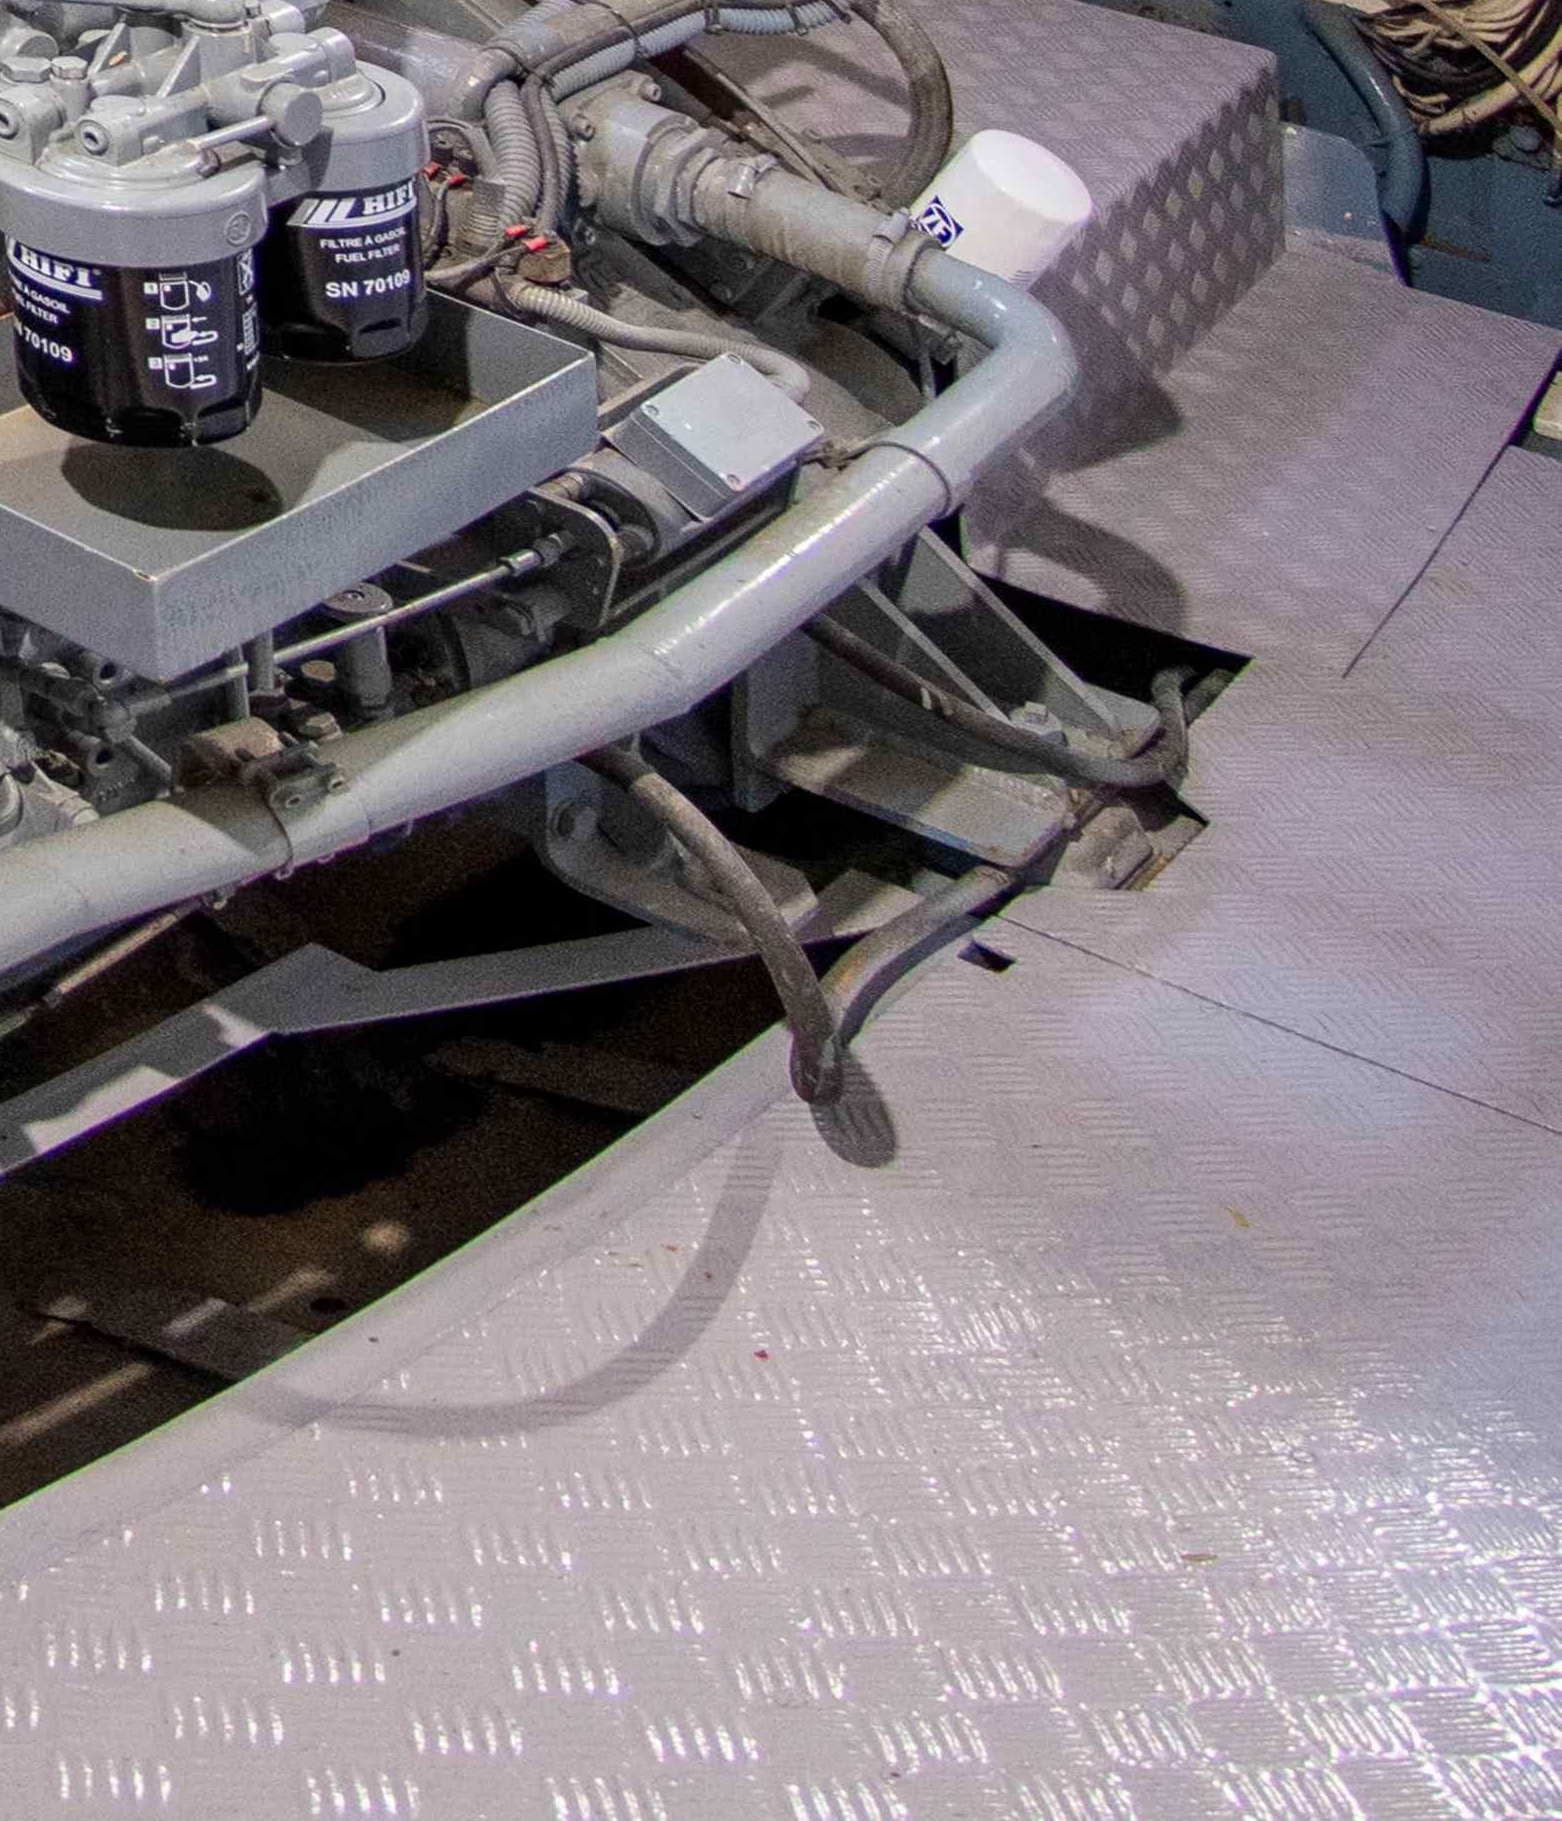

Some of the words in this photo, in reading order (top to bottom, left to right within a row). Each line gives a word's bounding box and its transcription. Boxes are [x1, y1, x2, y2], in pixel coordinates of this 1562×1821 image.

[362, 180, 415, 215] HIFI
[319, 237, 363, 249] FILTRE
[374, 226, 407, 244] GASOIL
[335, 251, 366, 263] FUEL
[368, 243, 400, 260] FILTER
[19, 244, 92, 288] HIFI
[324, 280, 359, 298] SN
[362, 268, 412, 296] 70109
[23, 325, 74, 363] 70109
